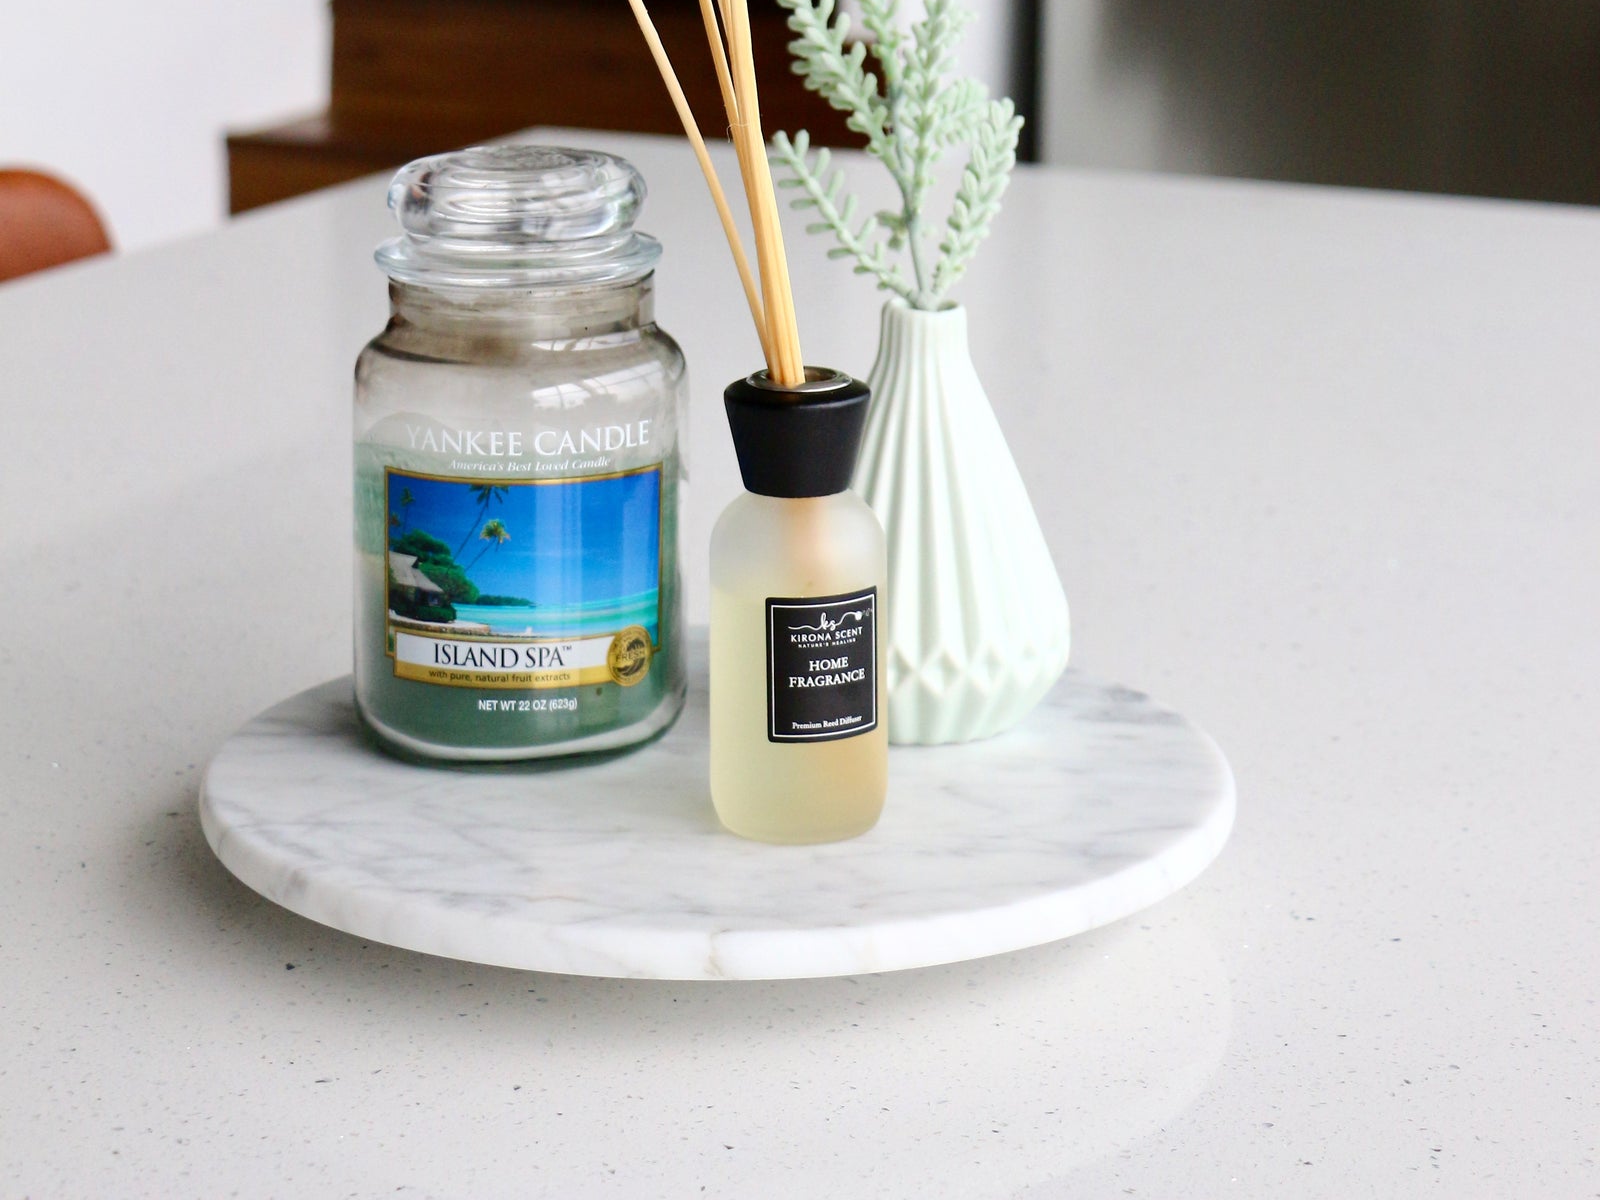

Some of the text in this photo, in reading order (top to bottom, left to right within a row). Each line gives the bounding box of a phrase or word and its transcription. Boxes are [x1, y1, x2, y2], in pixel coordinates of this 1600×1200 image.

[405, 419, 653, 456] YANKEE CANDLE
[449, 456, 611, 472] America's Best Loved Candle
[790, 626, 863, 643] KIRONA SCENT
[433, 643, 519, 668] ISLAND
[809, 656, 849, 671] HOME
[429, 670, 571, 683] with pure, natural fruit extracts
[789, 668, 866, 688] FRAGRANCE
[478, 697, 578, 712] NET WT 22 OZ (623g)
[792, 721, 822, 729] Premium
[823, 718, 839, 728] Reed
